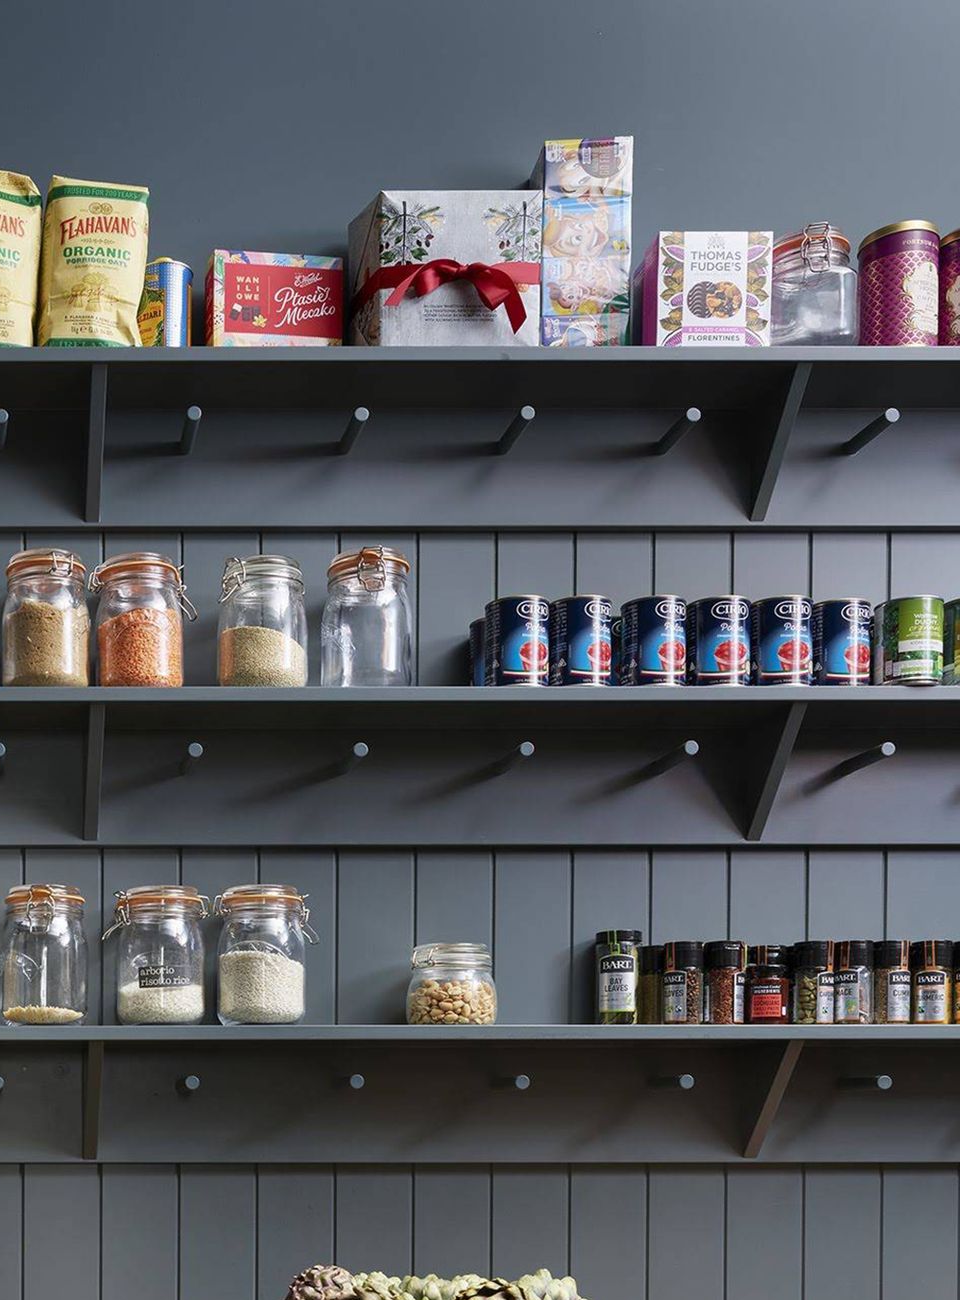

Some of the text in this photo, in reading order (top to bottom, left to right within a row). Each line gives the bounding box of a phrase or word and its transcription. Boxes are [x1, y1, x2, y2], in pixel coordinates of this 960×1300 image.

[59, 216, 137, 245] FLAHAVAN'S
[62, 246, 131, 262] ORGANIC
[690, 251, 742, 261] THOMAS
[690, 262, 742, 272] FUDGE'S
[688, 334, 740, 342] FLORENTINES
[715, 604, 747, 615] CIRIO
[140, 966, 175, 976] arborio
[140, 977, 172, 987] risotto
[604, 985, 629, 993] LEAVES
